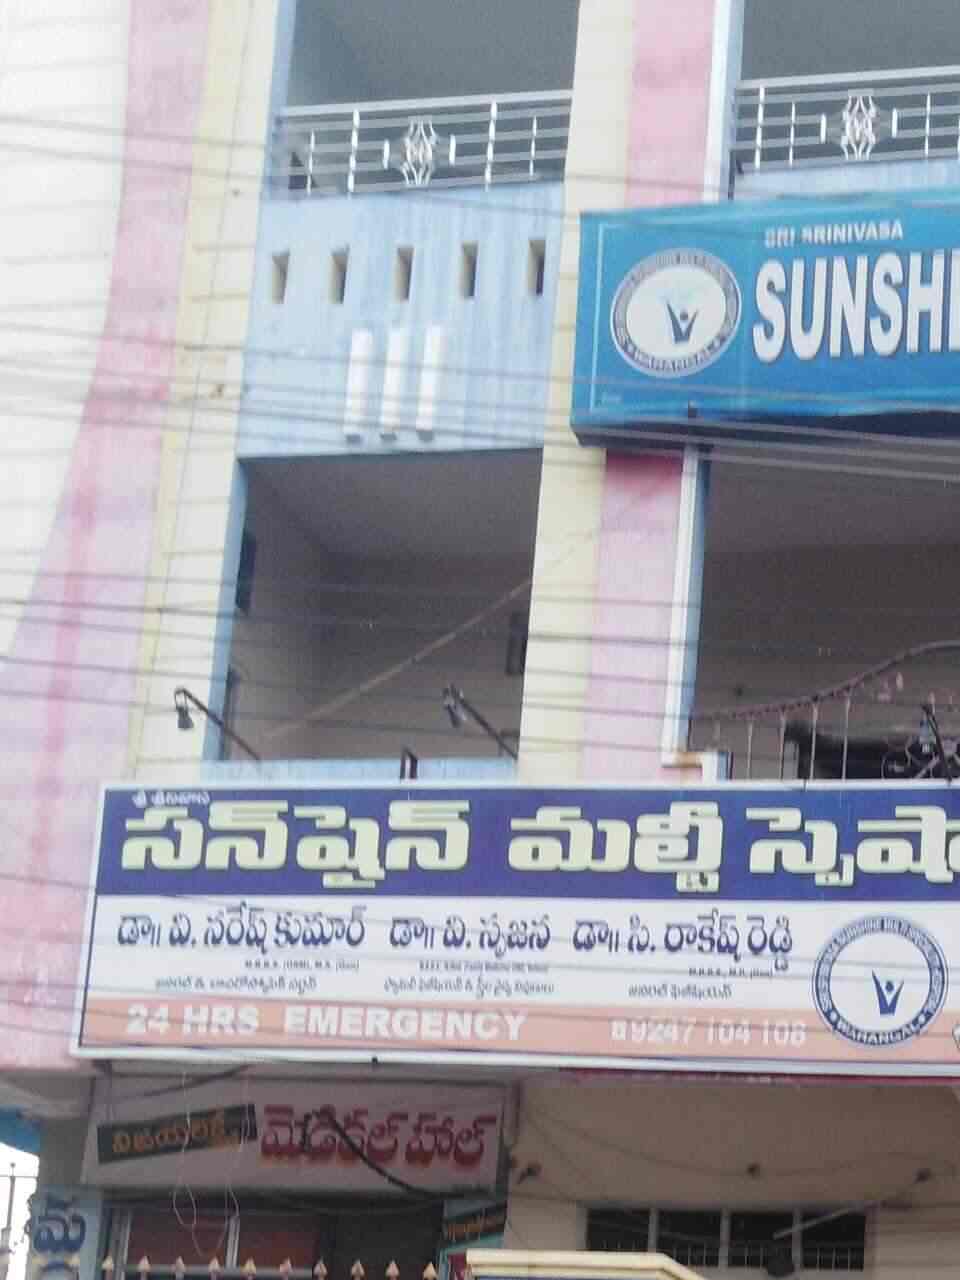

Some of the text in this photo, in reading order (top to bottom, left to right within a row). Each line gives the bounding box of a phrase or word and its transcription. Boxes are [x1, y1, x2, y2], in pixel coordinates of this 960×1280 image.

[127, 1003, 528, 1041] 24 HRS EMERGENCY
[703, 1016, 750, 1046] 104
